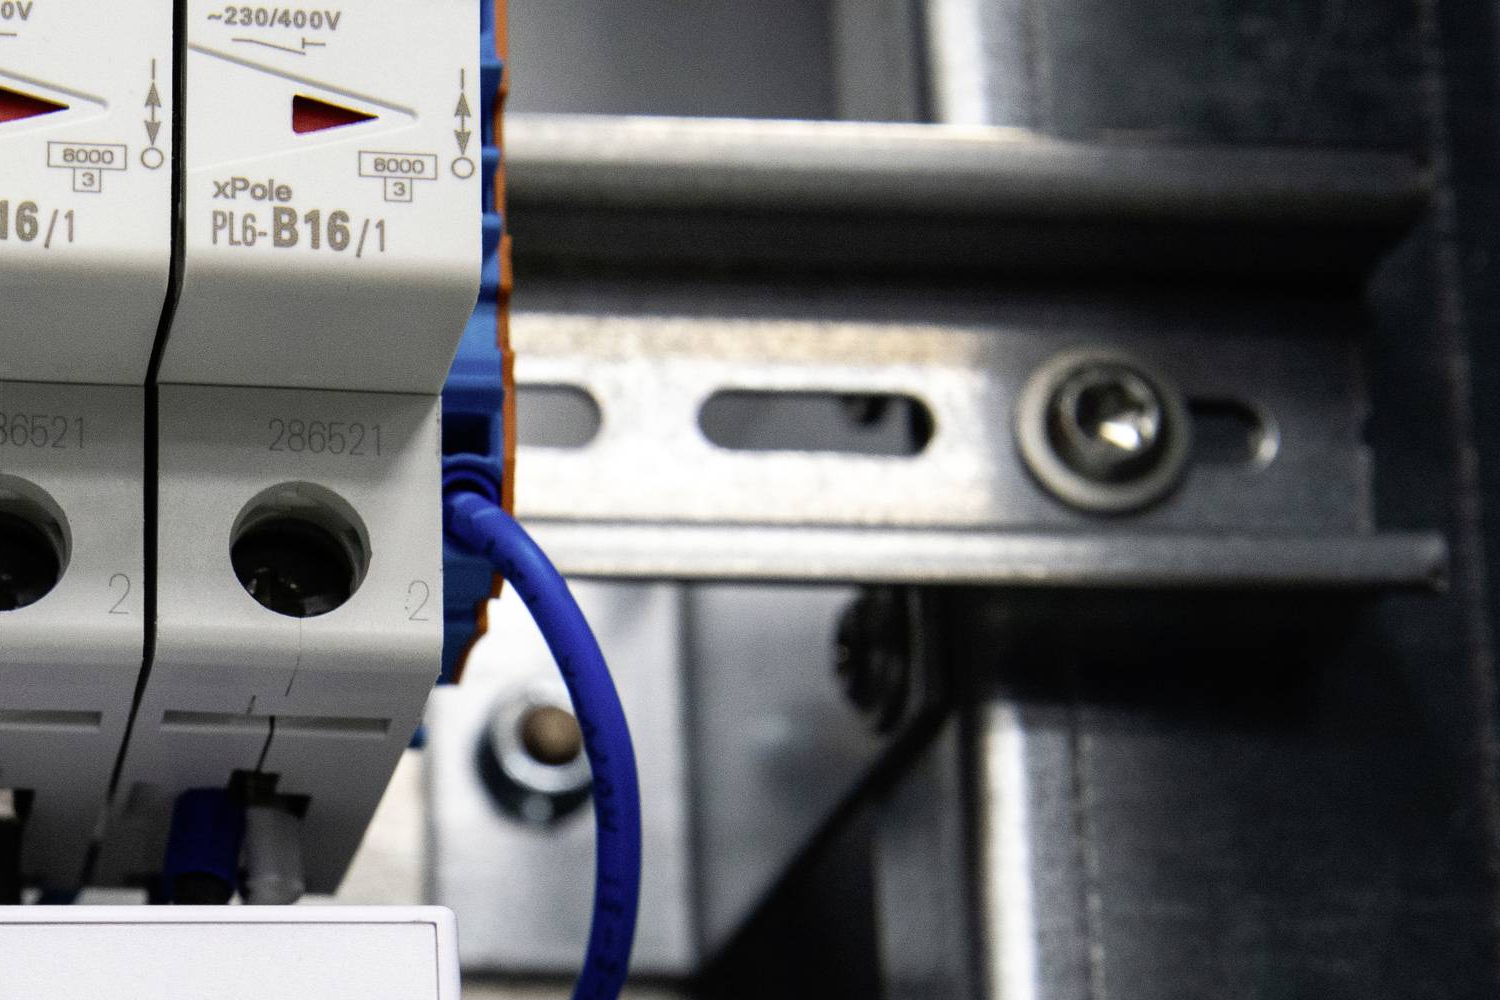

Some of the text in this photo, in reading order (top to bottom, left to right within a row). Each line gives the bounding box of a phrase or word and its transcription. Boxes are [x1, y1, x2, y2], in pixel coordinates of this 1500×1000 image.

[207, 6, 342, 31] ~230/400V
[62, 148, 115, 165] 6000
[372, 157, 425, 175] 6000
[81, 172, 95, 187] 3
[212, 176, 293, 203] xPole
[392, 181, 406, 197] 3
[211, 206, 386, 259] PL6-B16/1
[268, 418, 382, 457] 286521
[108, 573, 131, 614] 2
[407, 580, 430, 621] 2
